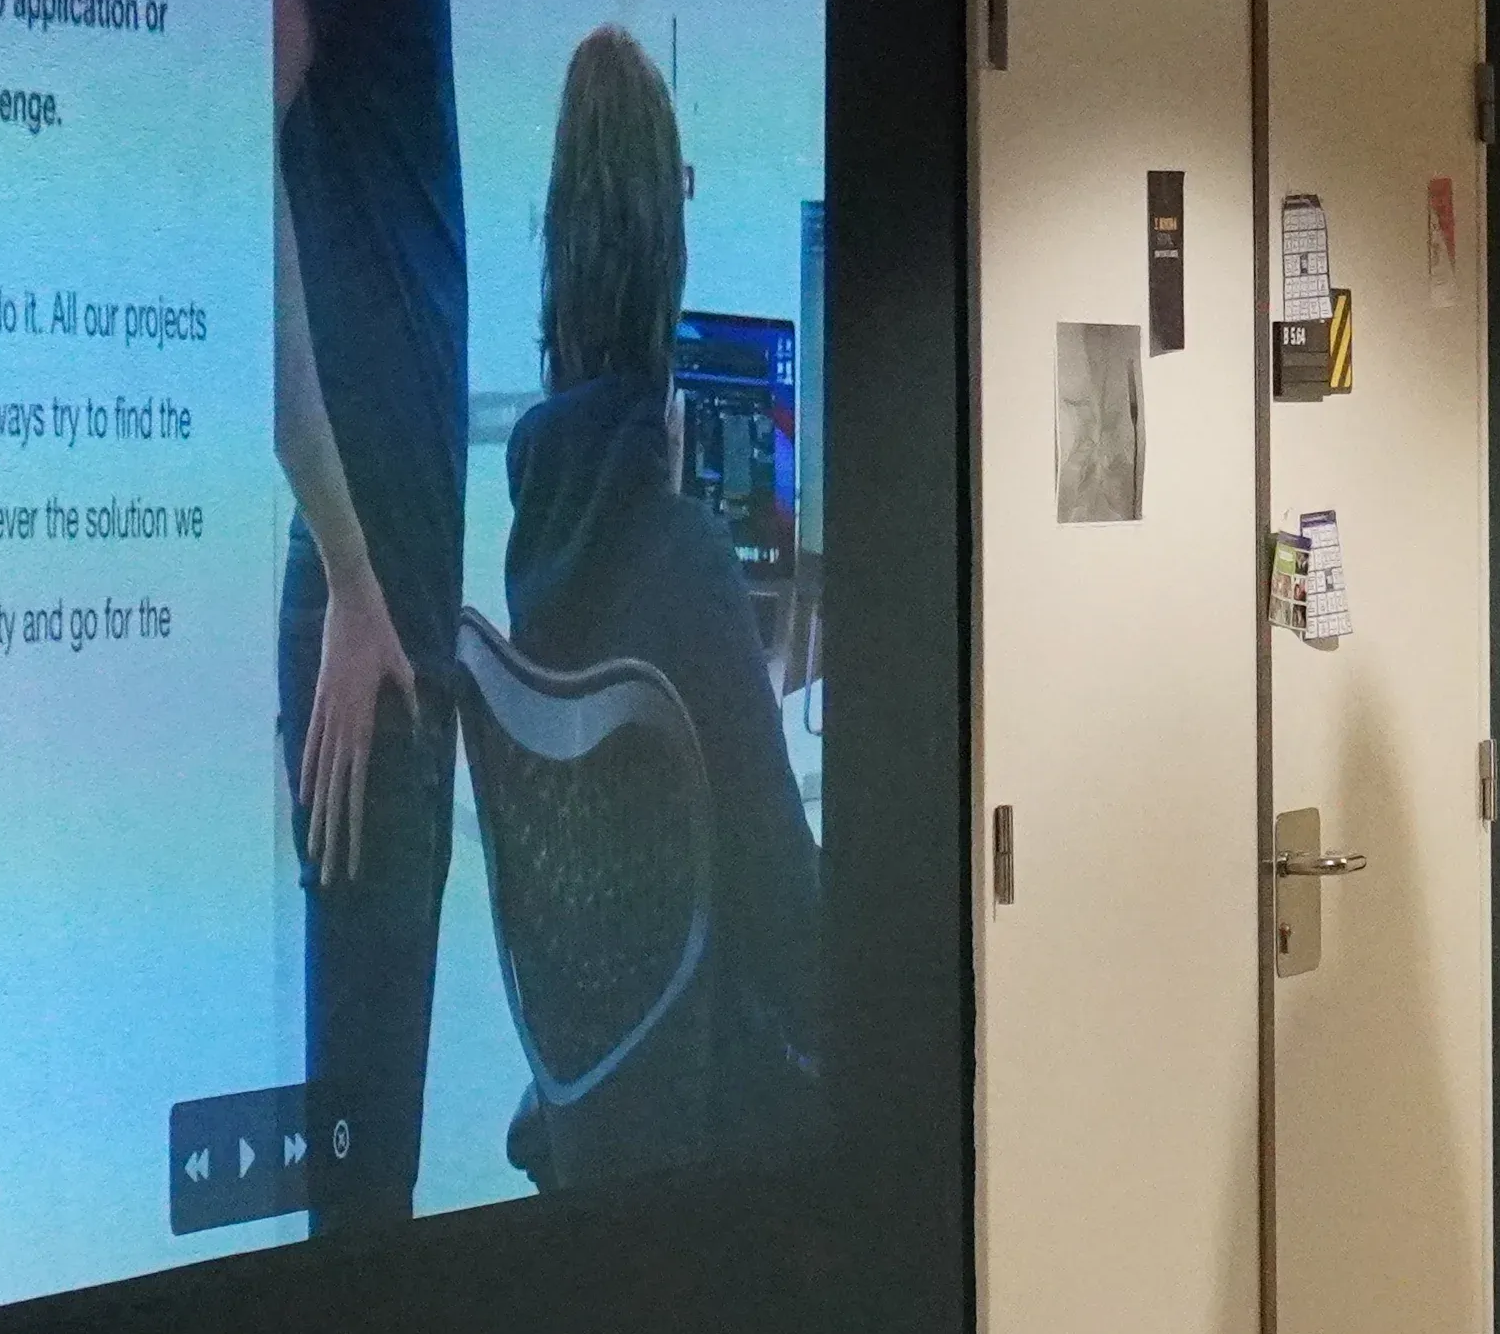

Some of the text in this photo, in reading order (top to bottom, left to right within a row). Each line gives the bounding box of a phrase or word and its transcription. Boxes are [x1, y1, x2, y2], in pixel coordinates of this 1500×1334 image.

[24, 291, 42, 335] it.
[50, 293, 77, 337] All
[83, 305, 118, 338] our
[125, 298, 207, 348] projects
[52, 400, 81, 446] try
[87, 400, 108, 438] to
[114, 397, 152, 440] find
[159, 397, 191, 440] the
[45, 497, 78, 541] the
[85, 498, 167, 540] solution
[174, 508, 203, 540] we
[23, 598, 63, 643] and
[70, 606, 98, 652] go
[104, 597, 132, 640] for
[138, 597, 171, 638] the
